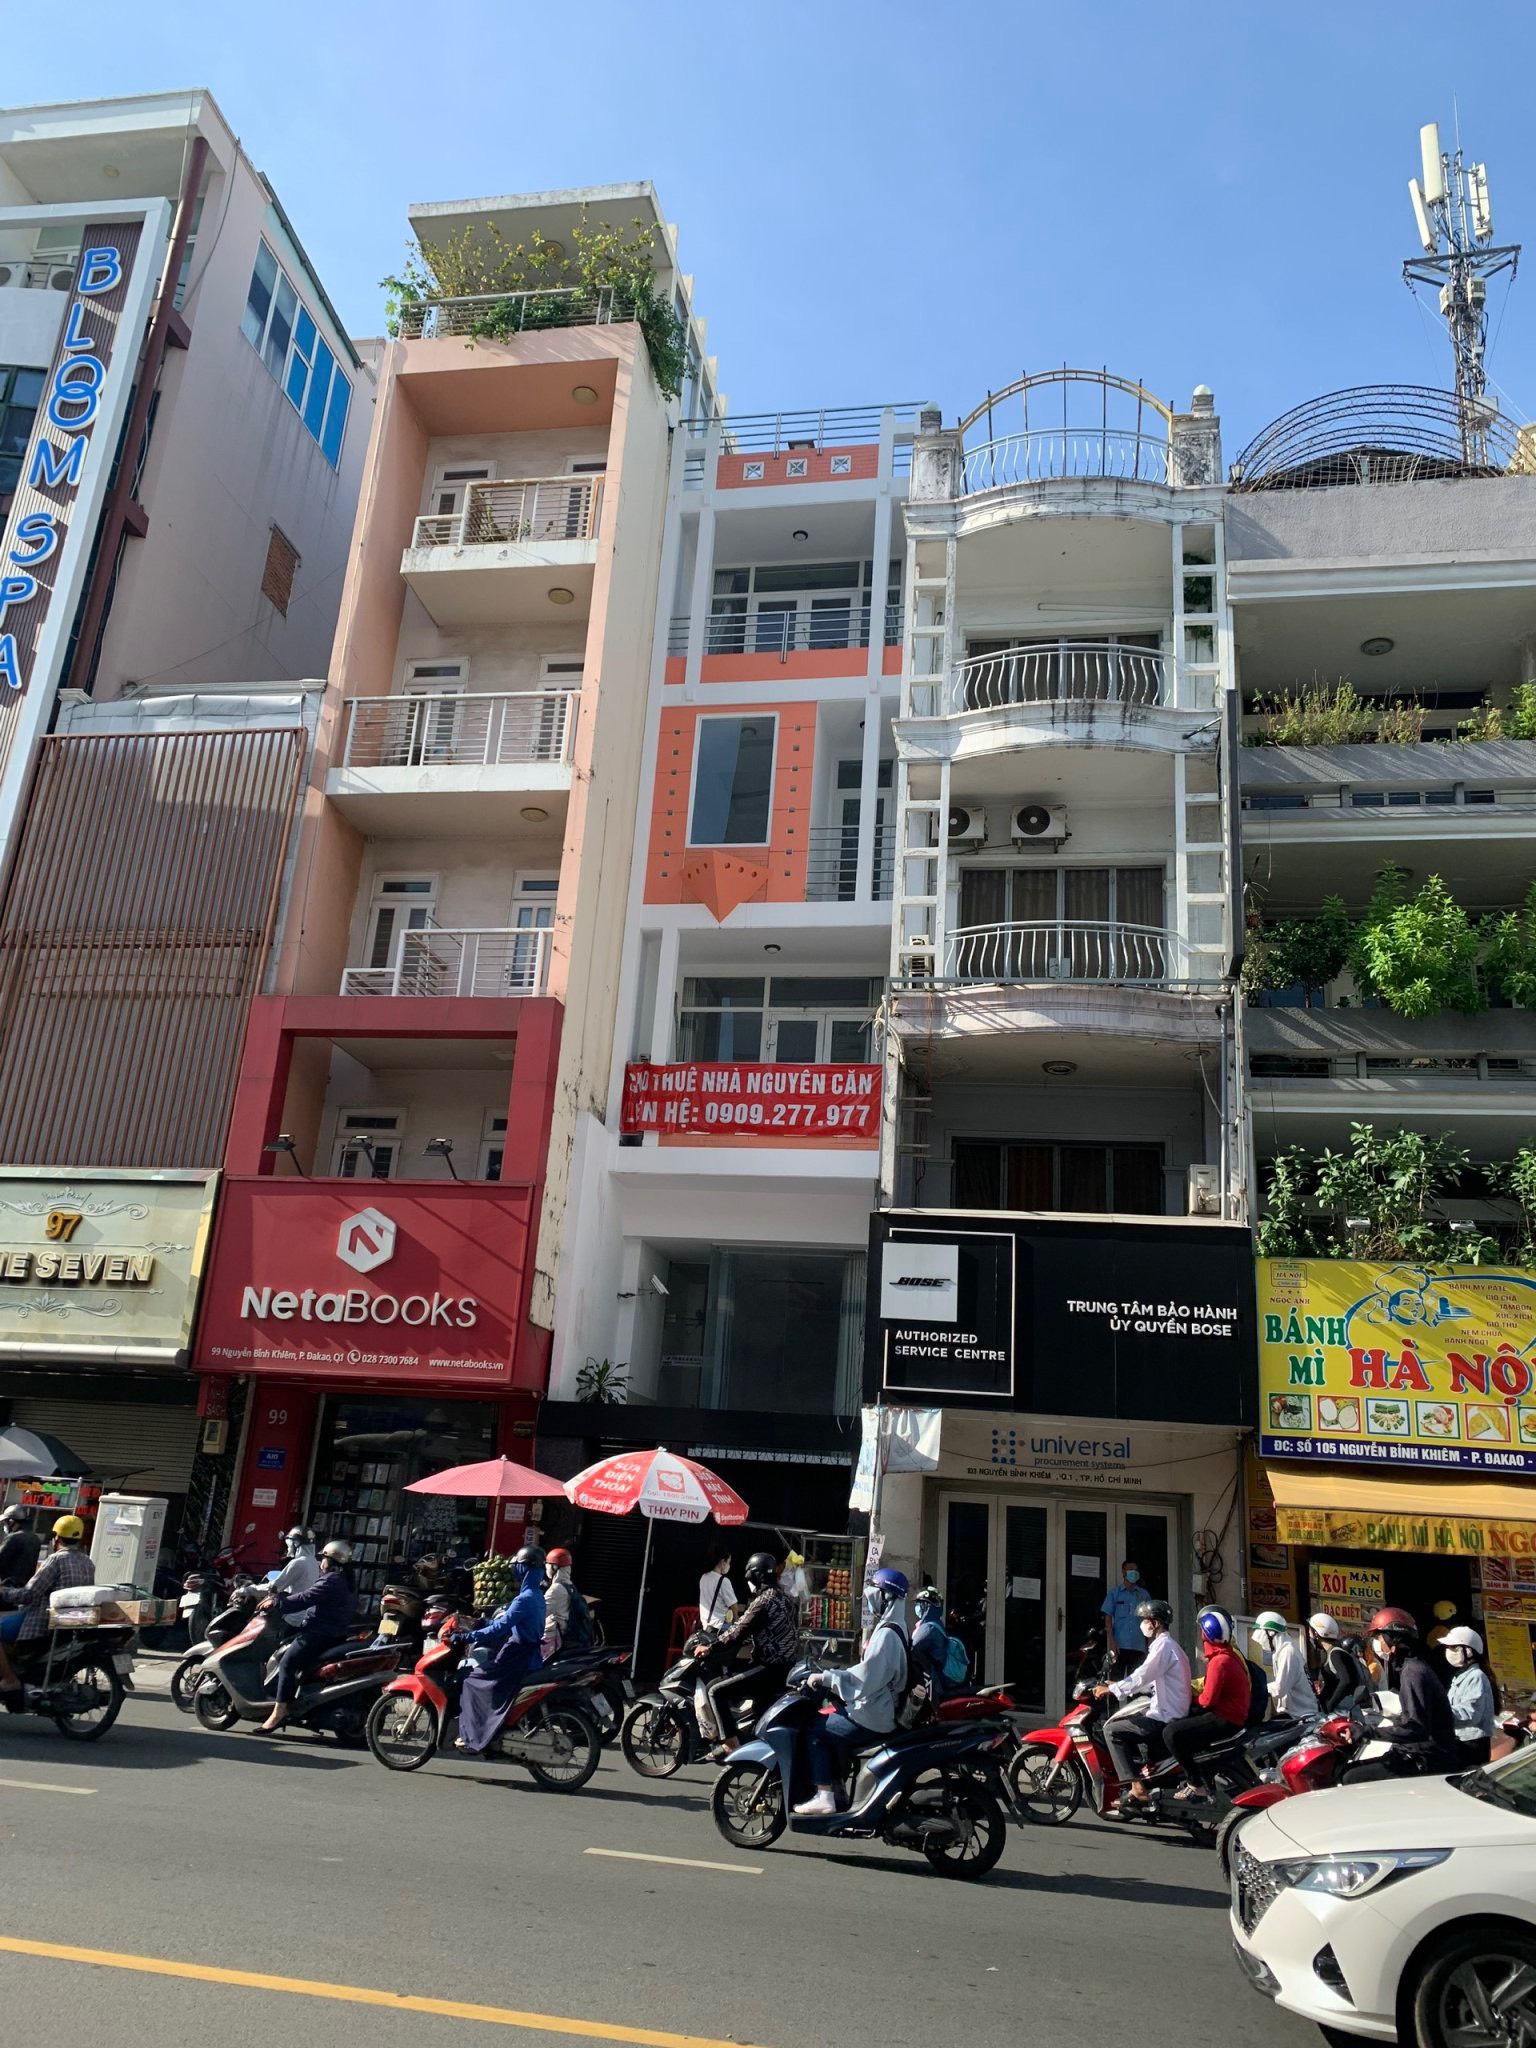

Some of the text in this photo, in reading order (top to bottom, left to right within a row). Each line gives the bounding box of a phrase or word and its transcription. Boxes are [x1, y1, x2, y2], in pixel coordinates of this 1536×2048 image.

[28, 246, 122, 488] BLOOM
[653, 1068, 698, 1093] THUÊ
[702, 1067, 741, 1093] NHÀ
[746, 1069, 826, 1095] NGUYÊN
[831, 1069, 873, 1095] CĂN
[663, 1098, 698, 1128] HỆ:
[704, 1102, 871, 1127] 0909.277.977
[45, 1211, 83, 1242] 97
[35, 1251, 156, 1282] SEVEN
[889, 1276, 951, 1288] BOSE
[1067, 1300, 1237, 1320] TRUNG TÂM BẢO HÀNH
[895, 1330, 978, 1344] AUTHORIZED
[1110, 1315, 1232, 1336] ỦY QUYỀN BOSE
[1264, 1307, 1348, 1347] BÁNH
[211, 1347, 221, 1356] 99
[306, 1351, 333, 1362] Đakao,
[333, 1353, 344, 1363] Q1
[362, 1354, 377, 1364] 028
[378, 1355, 398, 1365] 7300
[399, 1356, 419, 1366] 7684
[429, 1358, 504, 1370] www.netabooks.vn
[894, 1345, 1006, 1361] SERVICE CENTRE
[1289, 1348, 1326, 1386] MÌ
[1349, 1338, 1536, 1406] HÀ NỘ
[268, 1409, 288, 1425] 99
[1031, 1435, 1131, 1458] universal
[1274, 1440, 1294, 1452] ĐC:
[1297, 1437, 1312, 1453] SỐ
[1315, 1442, 1337, 1454] 105
[1339, 1441, 1387, 1457] NGUYỄN
[1421, 1445, 1460, 1462] KHIÊM
[1471, 1452, 1482, 1464] P.
[1484, 1453, 1525, 1467] ĐAKAO
[1034, 1457, 1126, 1470] procurement systems
[1123, 1477, 1142, 1485] MINH
[648, 1505, 700, 1520] THAY PIN
[1366, 1519, 1407, 1545] BÁNH
[1412, 1524, 1429, 1547] MÌ
[1434, 1521, 1455, 1548] HÀ
[1459, 1523, 1485, 1551] NỘI
[1322, 1569, 1347, 1594] XÔI
[1349, 1570, 1380, 1584] MẶN
[1349, 1585, 1382, 1599] KHÚC
[1341, 1604, 1361, 1621] BIỆT
